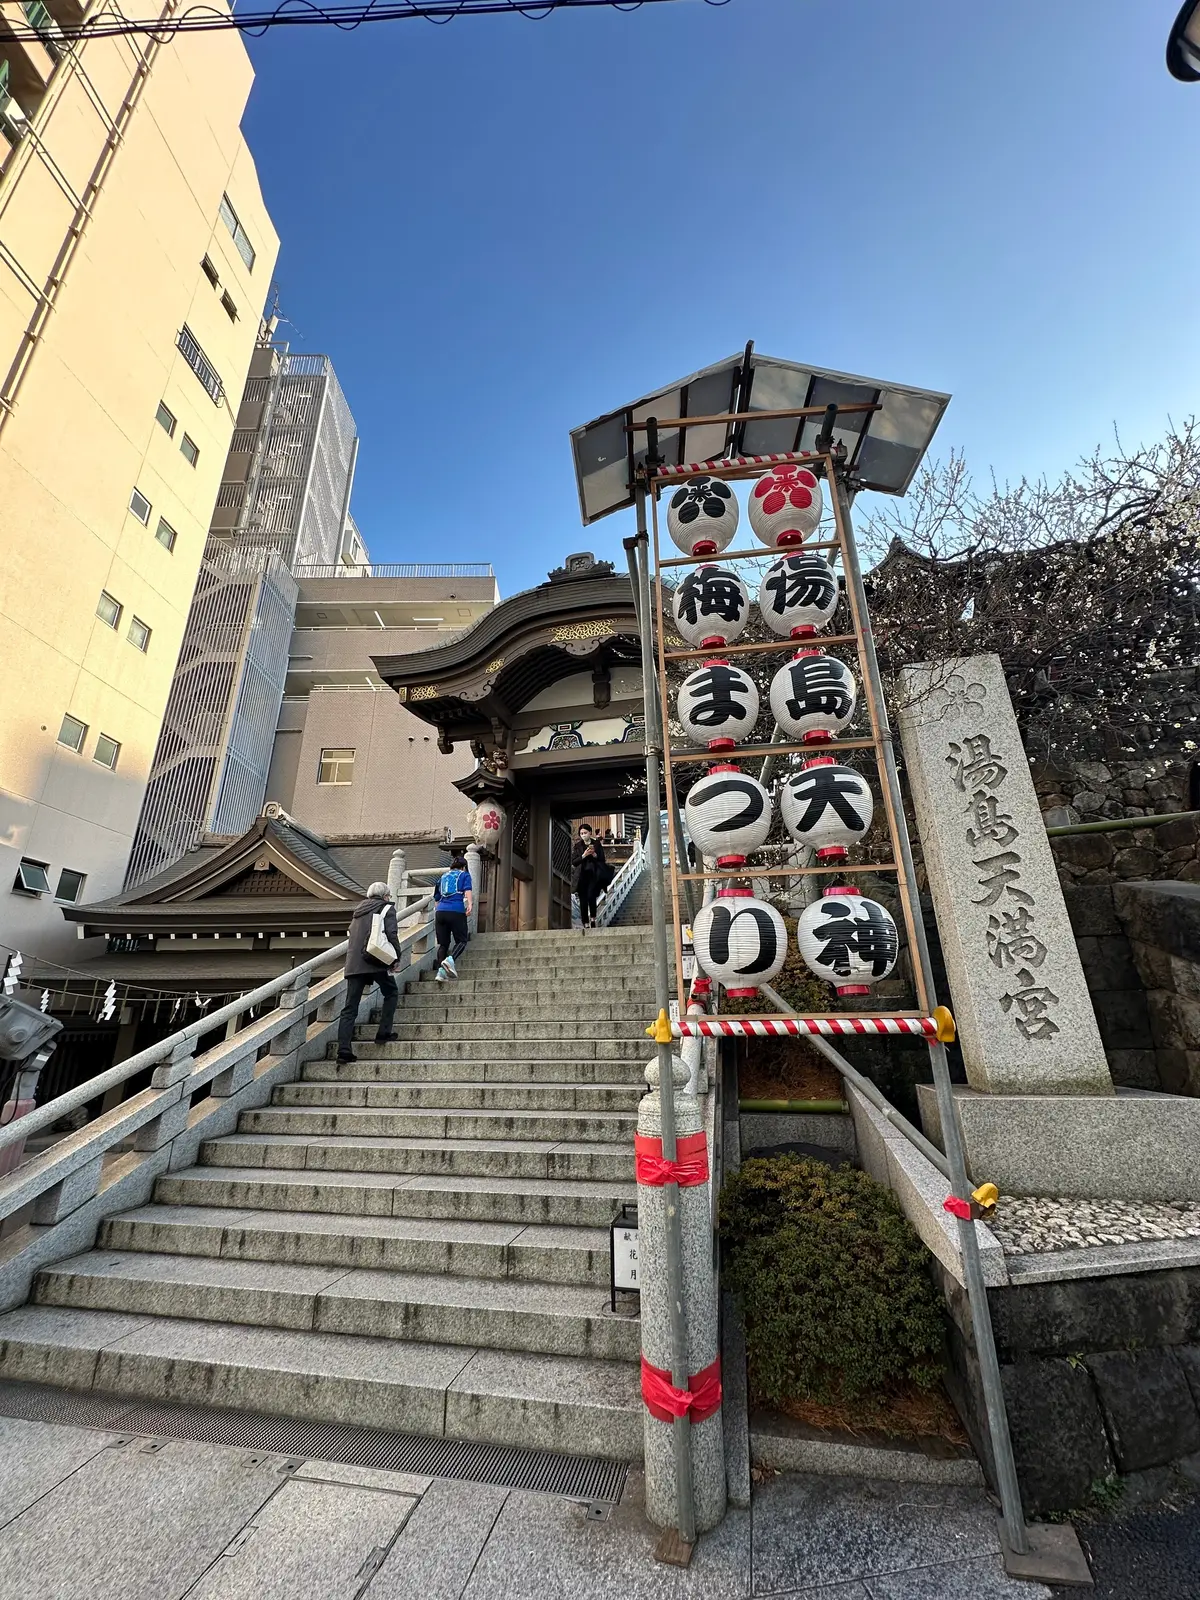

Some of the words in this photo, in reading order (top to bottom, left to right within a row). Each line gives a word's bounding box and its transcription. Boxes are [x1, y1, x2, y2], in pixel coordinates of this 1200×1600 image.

[677, 567, 777, 974] 梅まつり
[766, 554, 898, 977] 湯島天神
[945, 733, 1060, 1040] 湯島天満宮
